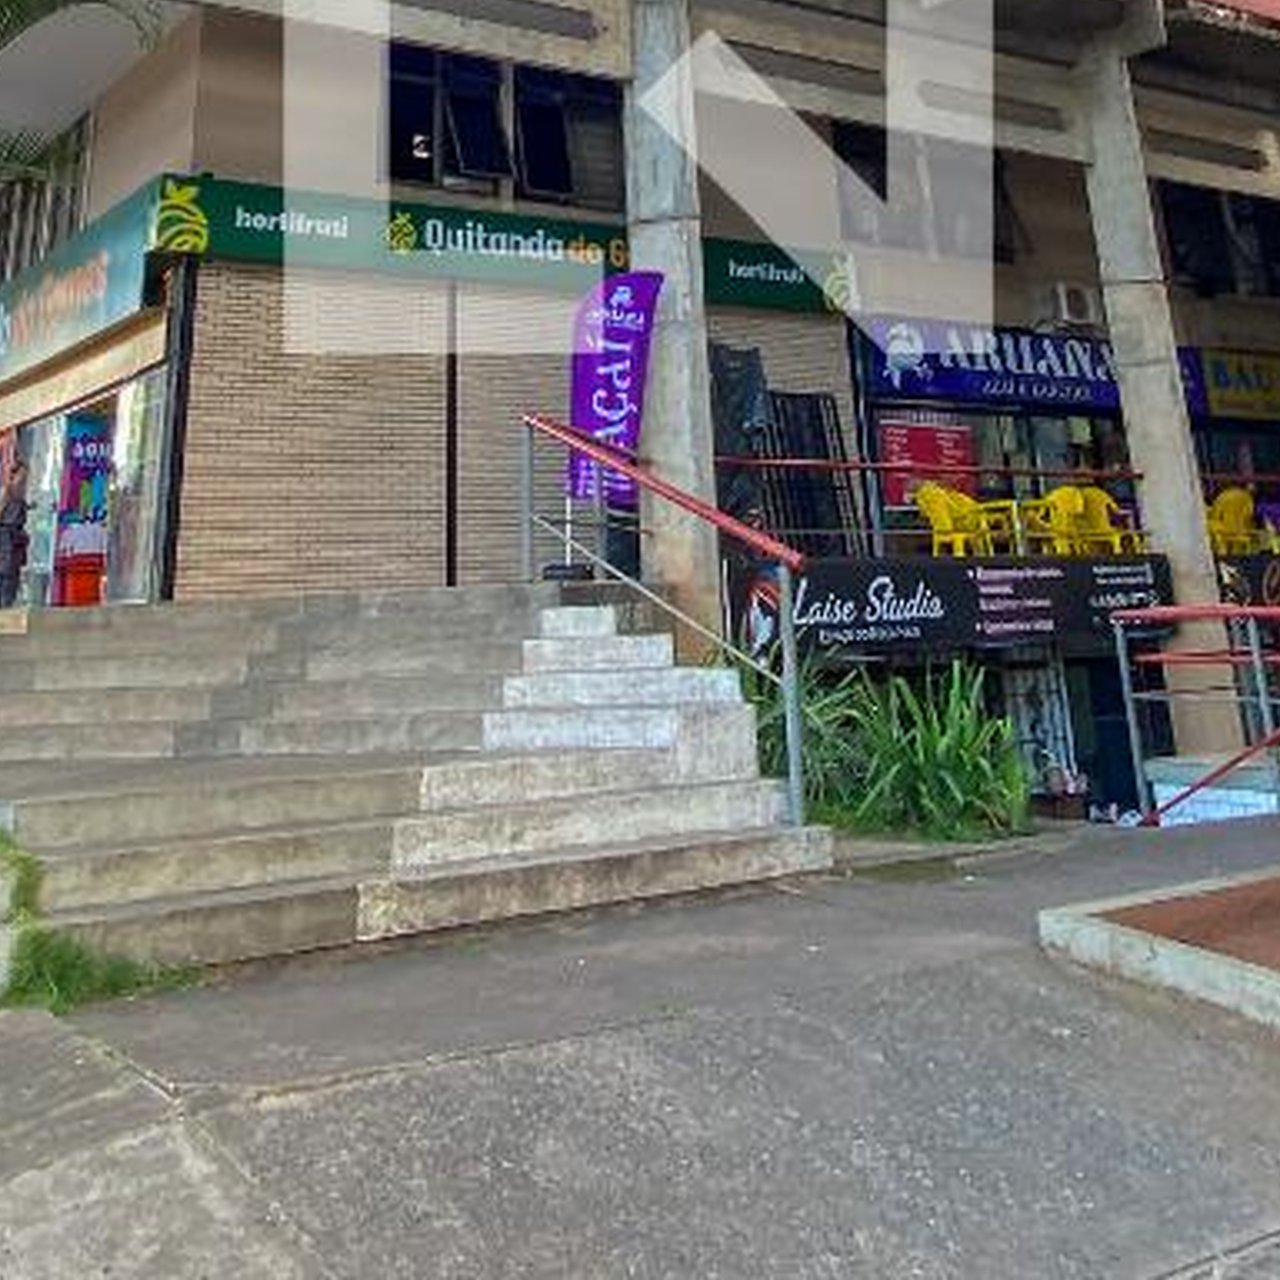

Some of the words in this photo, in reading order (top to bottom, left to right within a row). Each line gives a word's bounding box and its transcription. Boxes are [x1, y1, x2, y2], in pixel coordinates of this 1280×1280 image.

[235, 206, 349, 239] hortifruti
[425, 220, 564, 262] Quitanda
[793, 578, 856, 625] Laise
[865, 575, 946, 622] Studio
